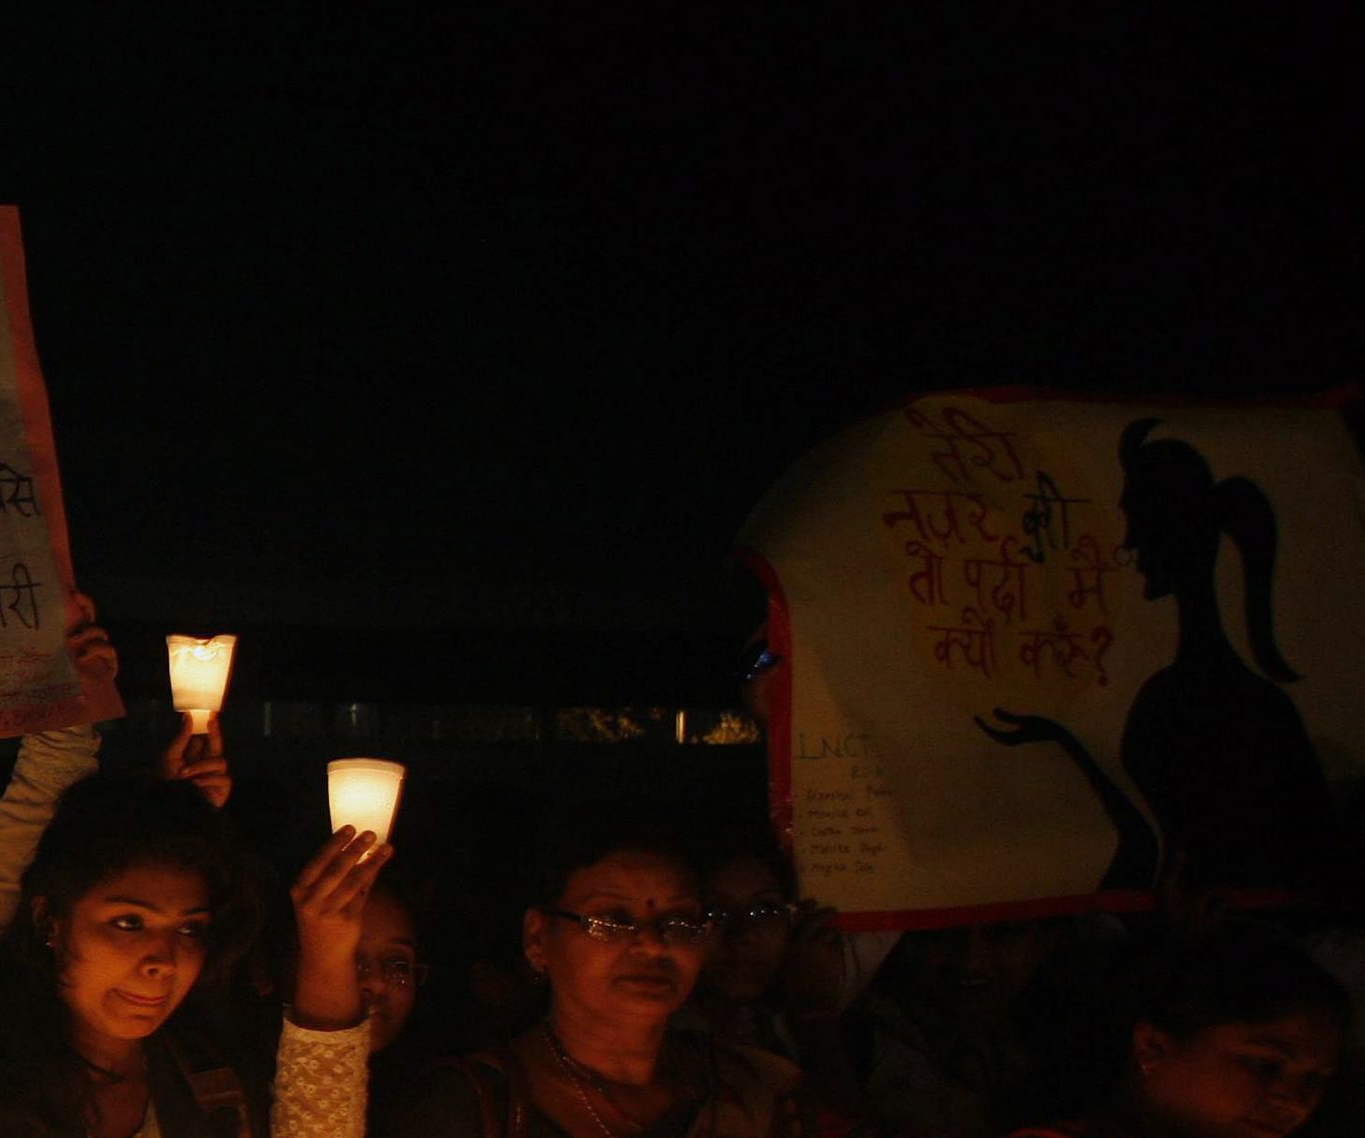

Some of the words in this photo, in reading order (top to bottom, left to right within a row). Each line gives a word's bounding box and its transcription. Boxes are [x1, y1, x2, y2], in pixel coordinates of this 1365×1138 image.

[905, 406, 1026, 484] तेरी
[904, 540, 951, 608] तो
[927, 604, 1001, 679] क्यों
